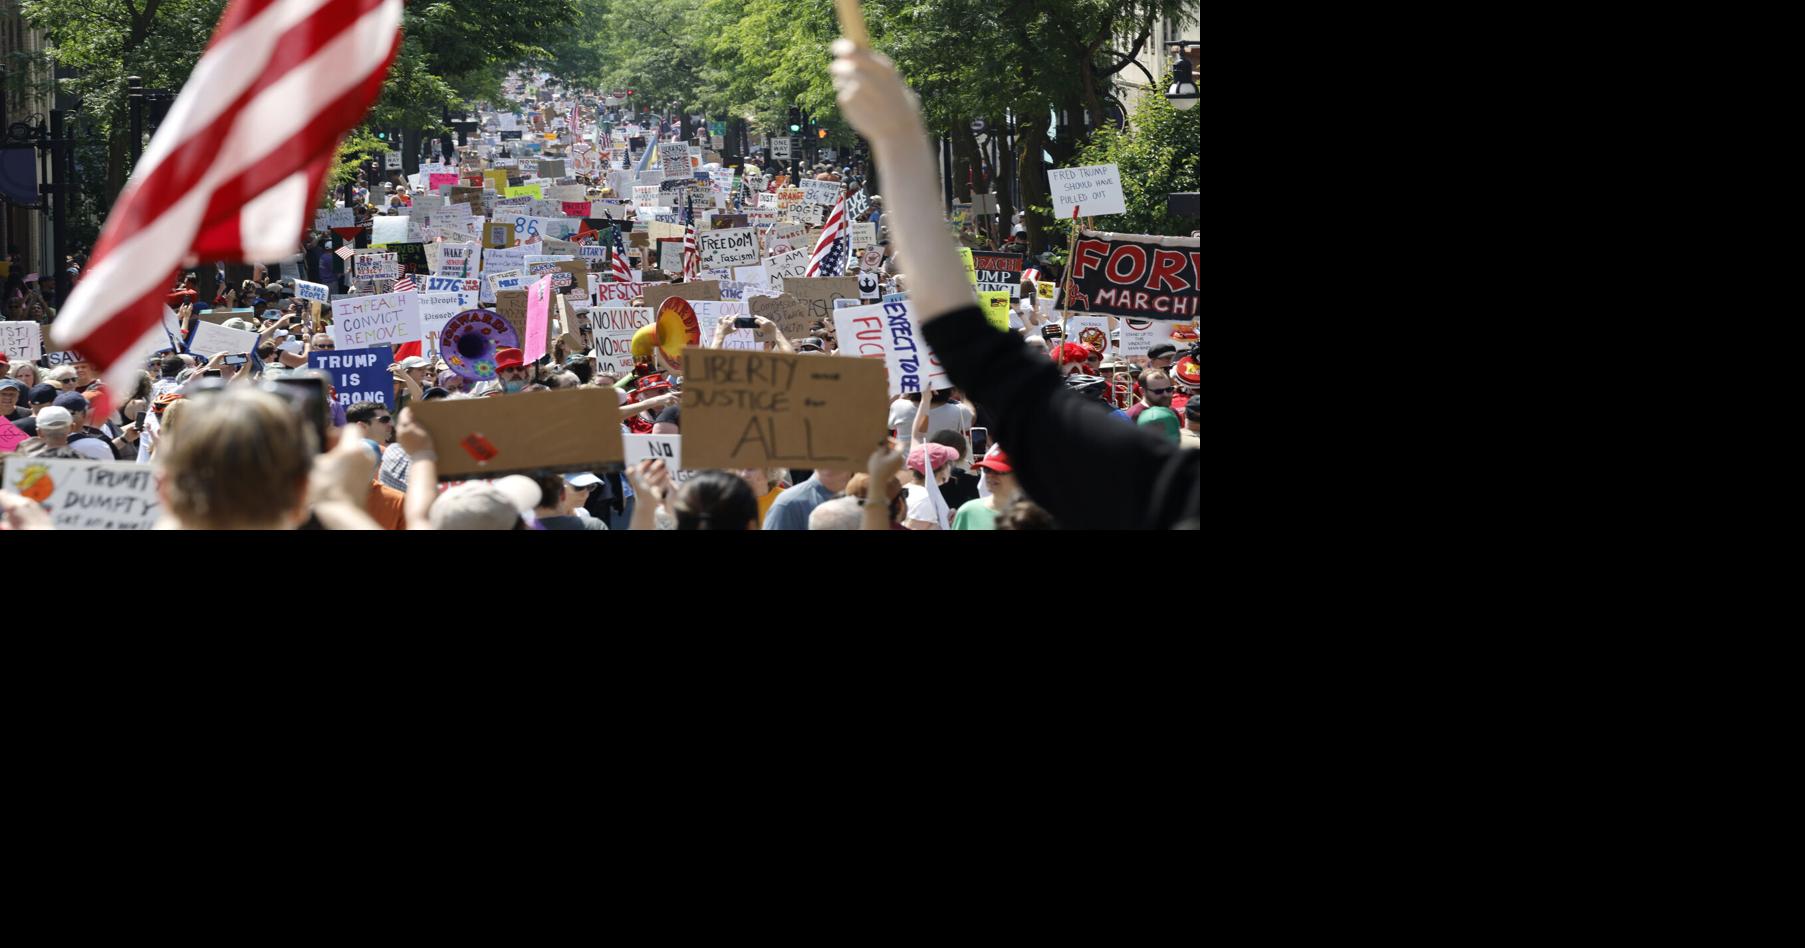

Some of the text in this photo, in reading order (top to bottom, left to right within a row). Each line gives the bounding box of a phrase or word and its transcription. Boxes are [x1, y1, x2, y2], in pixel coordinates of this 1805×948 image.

[1053, 166, 1108, 181] FRED TRUMP
[1064, 178, 1114, 191] SHOULD HAVE
[1060, 190, 1107, 204] PULLED OUT
[790, 205, 819, 215] DOGE
[514, 217, 539, 235] 86
[701, 232, 753, 251] FREEDOM
[785, 250, 803, 262] AM
[975, 256, 1014, 271] EACH
[771, 266, 806, 284] MAD
[1072, 239, 1200, 293] FOR
[428, 278, 460, 292] 1776
[977, 284, 1014, 296] ING!
[300, 290, 326, 301] PEOPLE
[339, 295, 406, 316] IMPEACH
[343, 309, 404, 332] CONVICT
[593, 310, 649, 329] NO KINGS
[345, 322, 408, 345] REMOVE
[852, 316, 886, 359] FUC
[596, 337, 613, 356] NO
[883, 302, 920, 394] EXPECT TO BE
[317, 354, 377, 369] TRUMP
[341, 374, 360, 387] IS
[683, 355, 799, 391] LIBERTY
[335, 390, 385, 406] RONG
[684, 388, 789, 412] JUSTICE
[730, 416, 849, 462] ALL
[648, 441, 673, 458] NO
[85, 466, 151, 493] TRUMPT
[64, 491, 157, 516] DUMPTY
